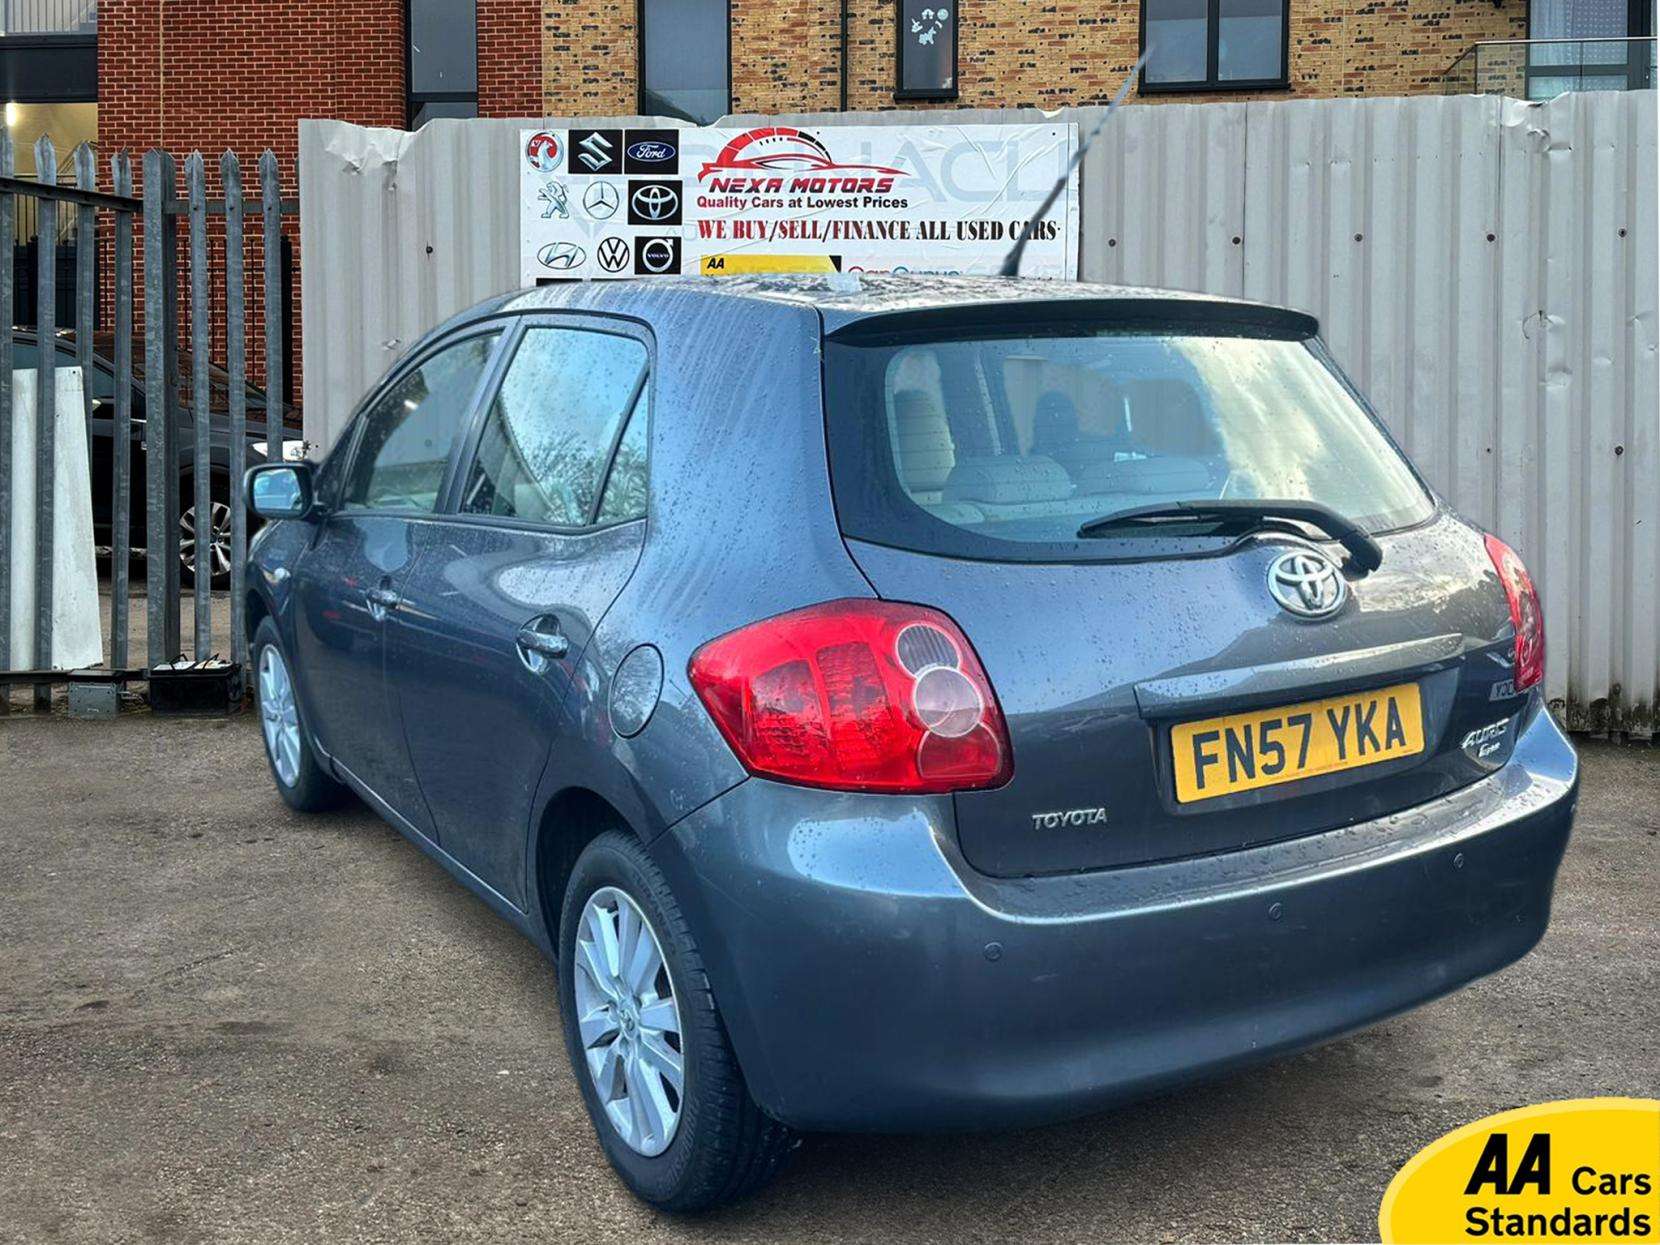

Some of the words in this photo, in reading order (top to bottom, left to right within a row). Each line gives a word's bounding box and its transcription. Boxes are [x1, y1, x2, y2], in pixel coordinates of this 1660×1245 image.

[637, 144, 666, 159] Ford
[708, 177, 784, 194] NEXA
[789, 177, 894, 194] MOTORS
[697, 196, 747, 209] Quality
[751, 196, 785, 208] Cars
[788, 197, 803, 208] at
[807, 196, 859, 208] Lowest
[862, 196, 908, 208] Prices
[697, 220, 727, 240] WE
[732, 218, 911, 242] BUY/SELL/FINANCE
[916, 220, 951, 239] ALL
[955, 220, 1003, 240] USED
[707, 258, 725, 269] AA
[1194, 712, 1314, 790] FN57
[1327, 695, 1408, 761] YKA
[1032, 808, 1107, 830] TOYOTA
